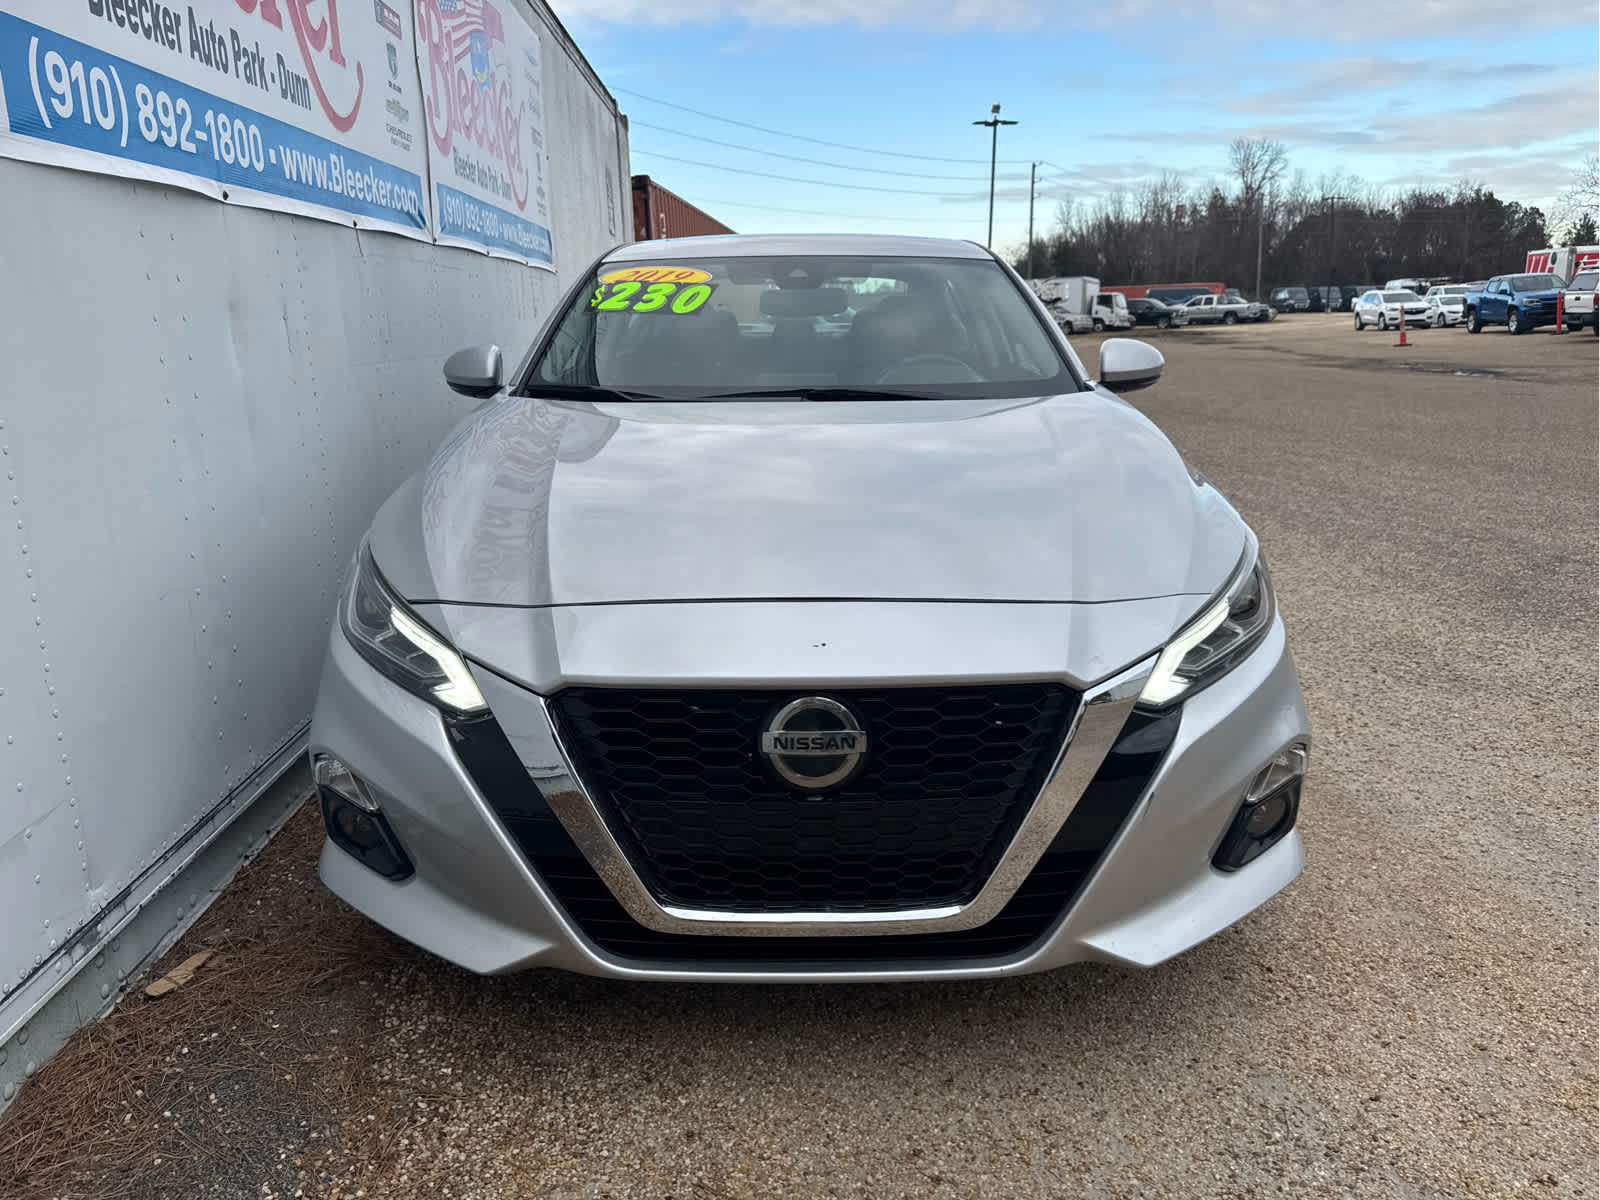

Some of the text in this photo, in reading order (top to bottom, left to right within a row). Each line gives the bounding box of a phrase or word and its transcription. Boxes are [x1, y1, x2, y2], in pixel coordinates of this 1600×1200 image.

[88, 0, 183, 53] eecker
[187, 6, 229, 74] Auto
[229, 28, 269, 92] Park
[276, 52, 312, 111] Dunn
[28, 36, 419, 217] (910) 892-1800 www.Bleecker.com
[621, 269, 695, 282] 2019
[591, 281, 712, 314] $230
[773, 735, 857, 751] NISSAN
